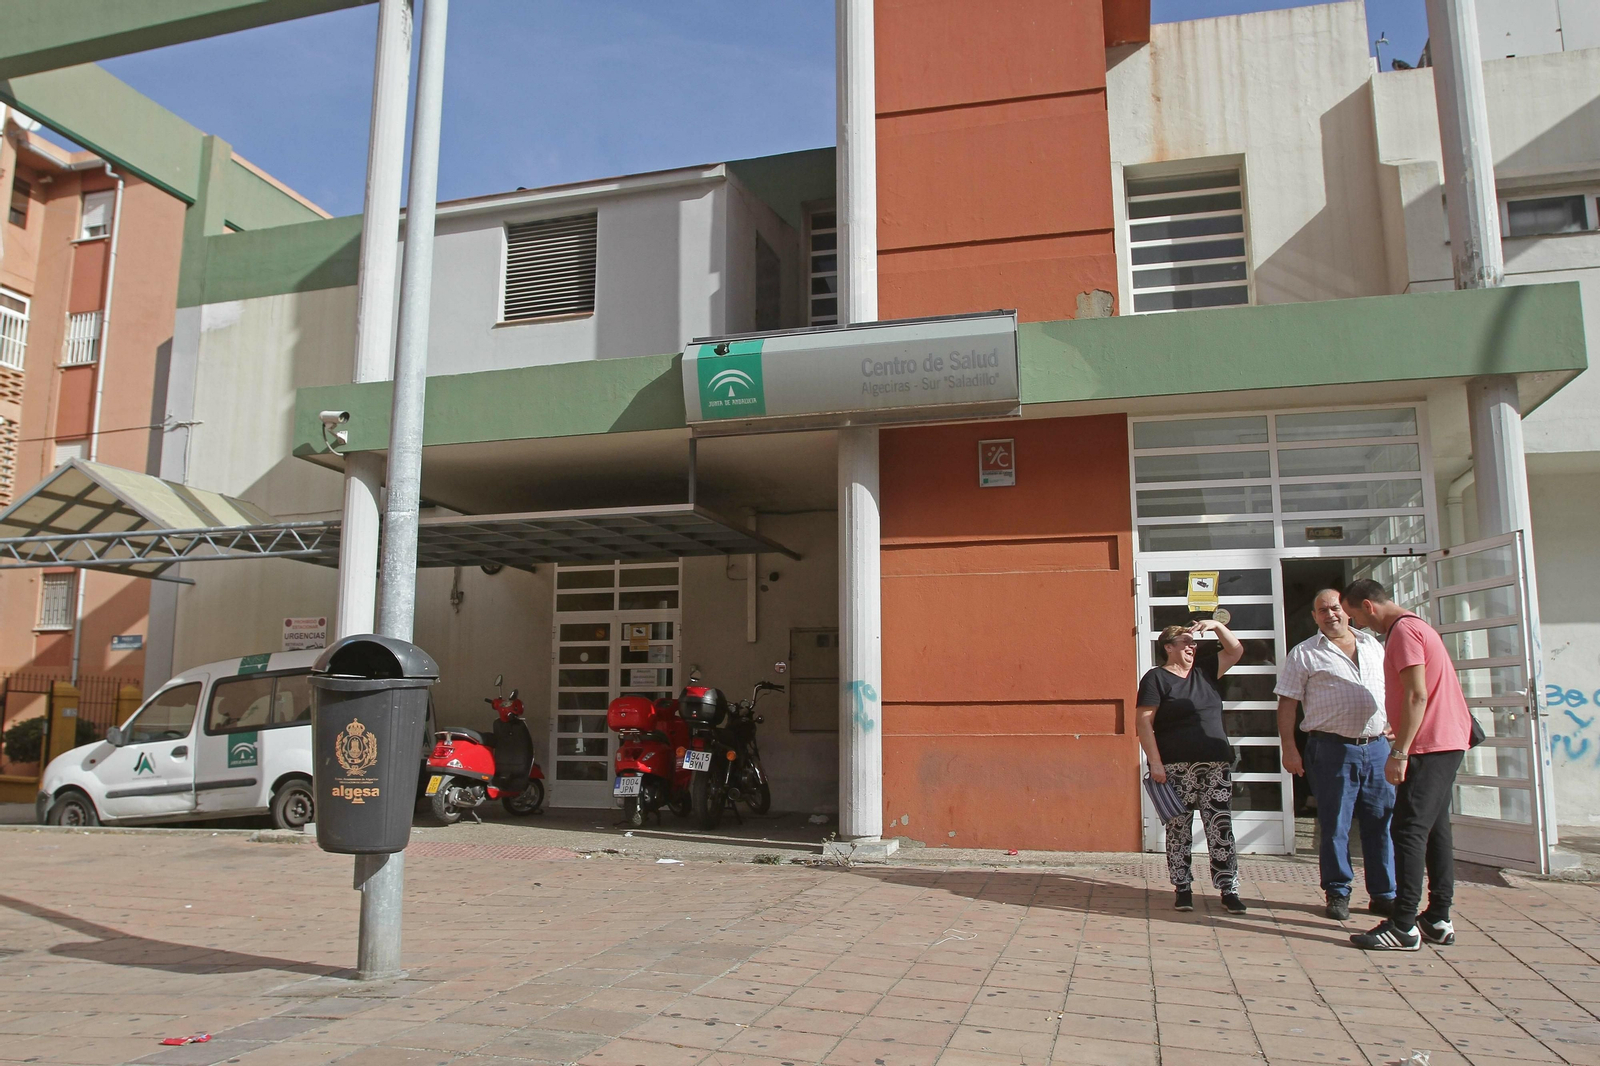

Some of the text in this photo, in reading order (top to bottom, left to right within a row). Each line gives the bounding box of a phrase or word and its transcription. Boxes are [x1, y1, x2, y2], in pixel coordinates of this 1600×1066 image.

[861, 348, 999, 377] Centro de Salud
[861, 380, 911, 397] Algeciras
[921, 377, 941, 391] Sur
[943, 372, 1000, 389] "Saladillo"
[690, 752, 710, 761] 9415
[689, 761, 704, 769] BYN
[621, 778, 639, 786] 1004
[331, 784, 380, 800] algesa
